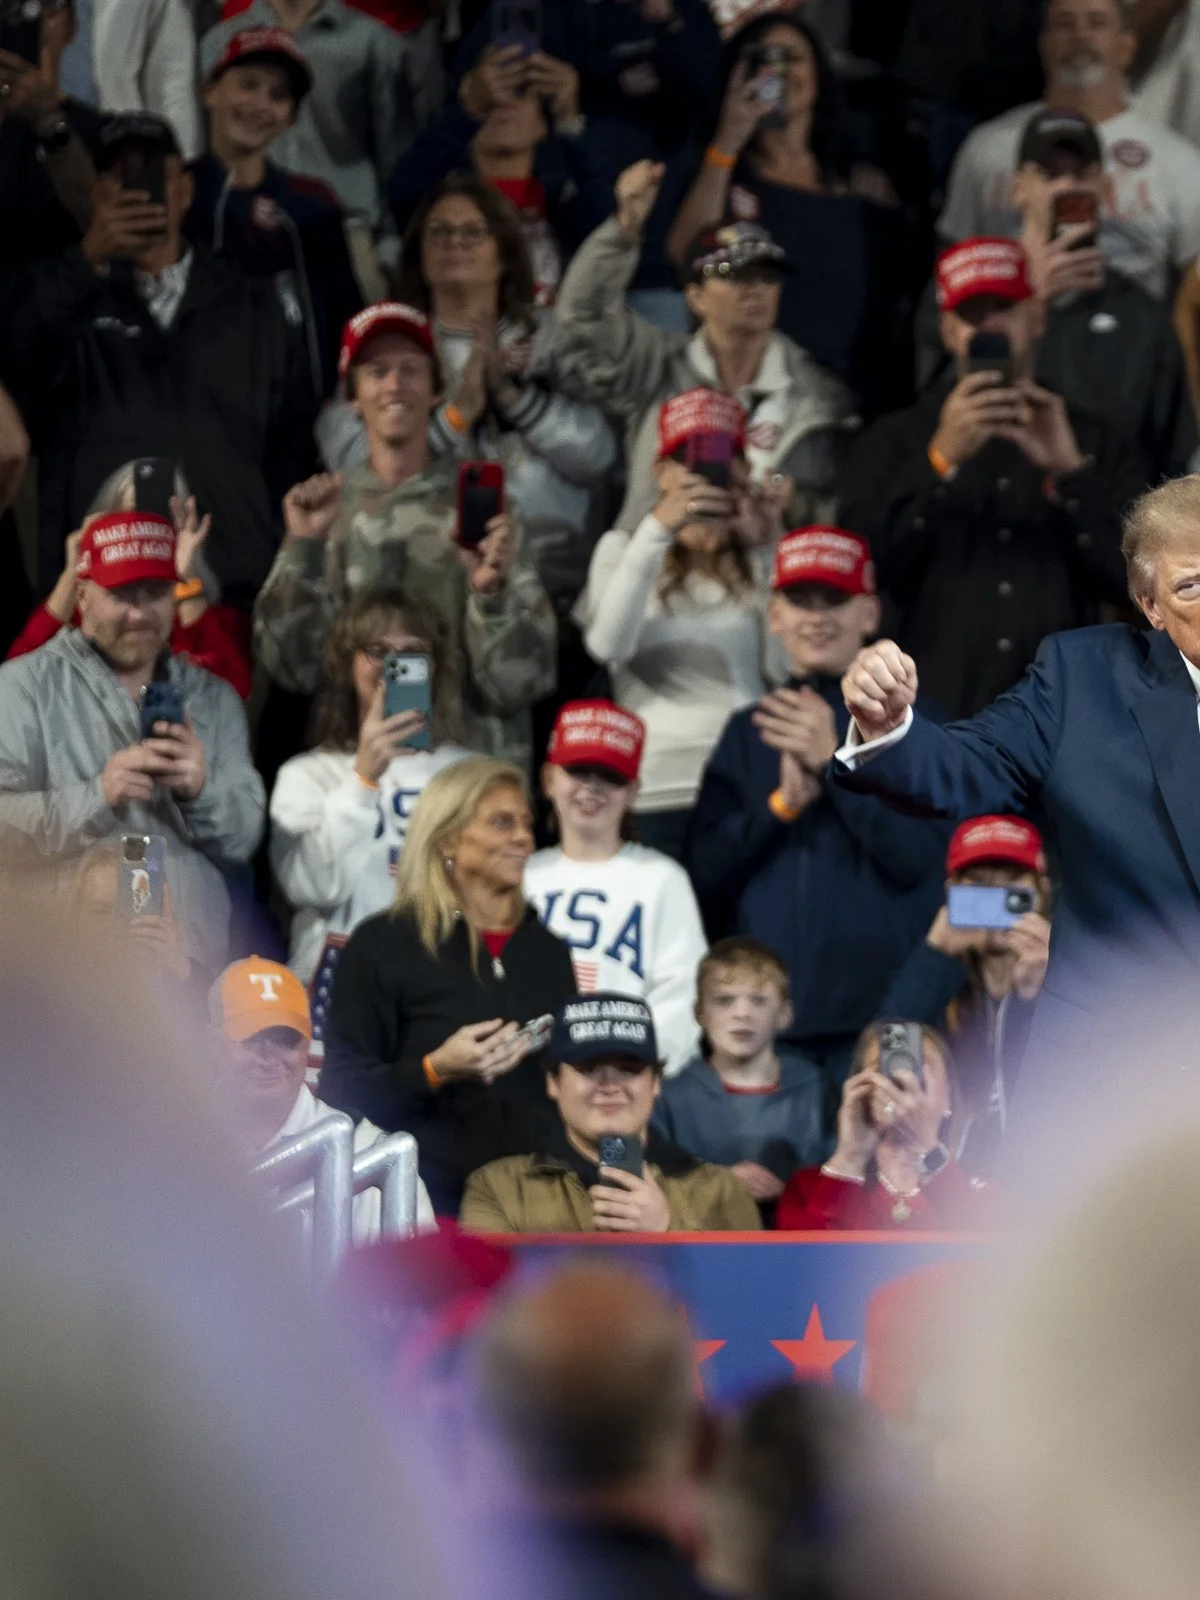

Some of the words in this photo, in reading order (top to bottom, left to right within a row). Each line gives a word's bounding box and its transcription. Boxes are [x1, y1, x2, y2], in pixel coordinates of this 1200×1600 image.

[93, 523, 128, 548] MAKE
[249, 972, 284, 1002] T
[563, 1000, 600, 1022] MAKE
[569, 1020, 611, 1042] GREAT
[612, 1020, 647, 1042] AGAIN
